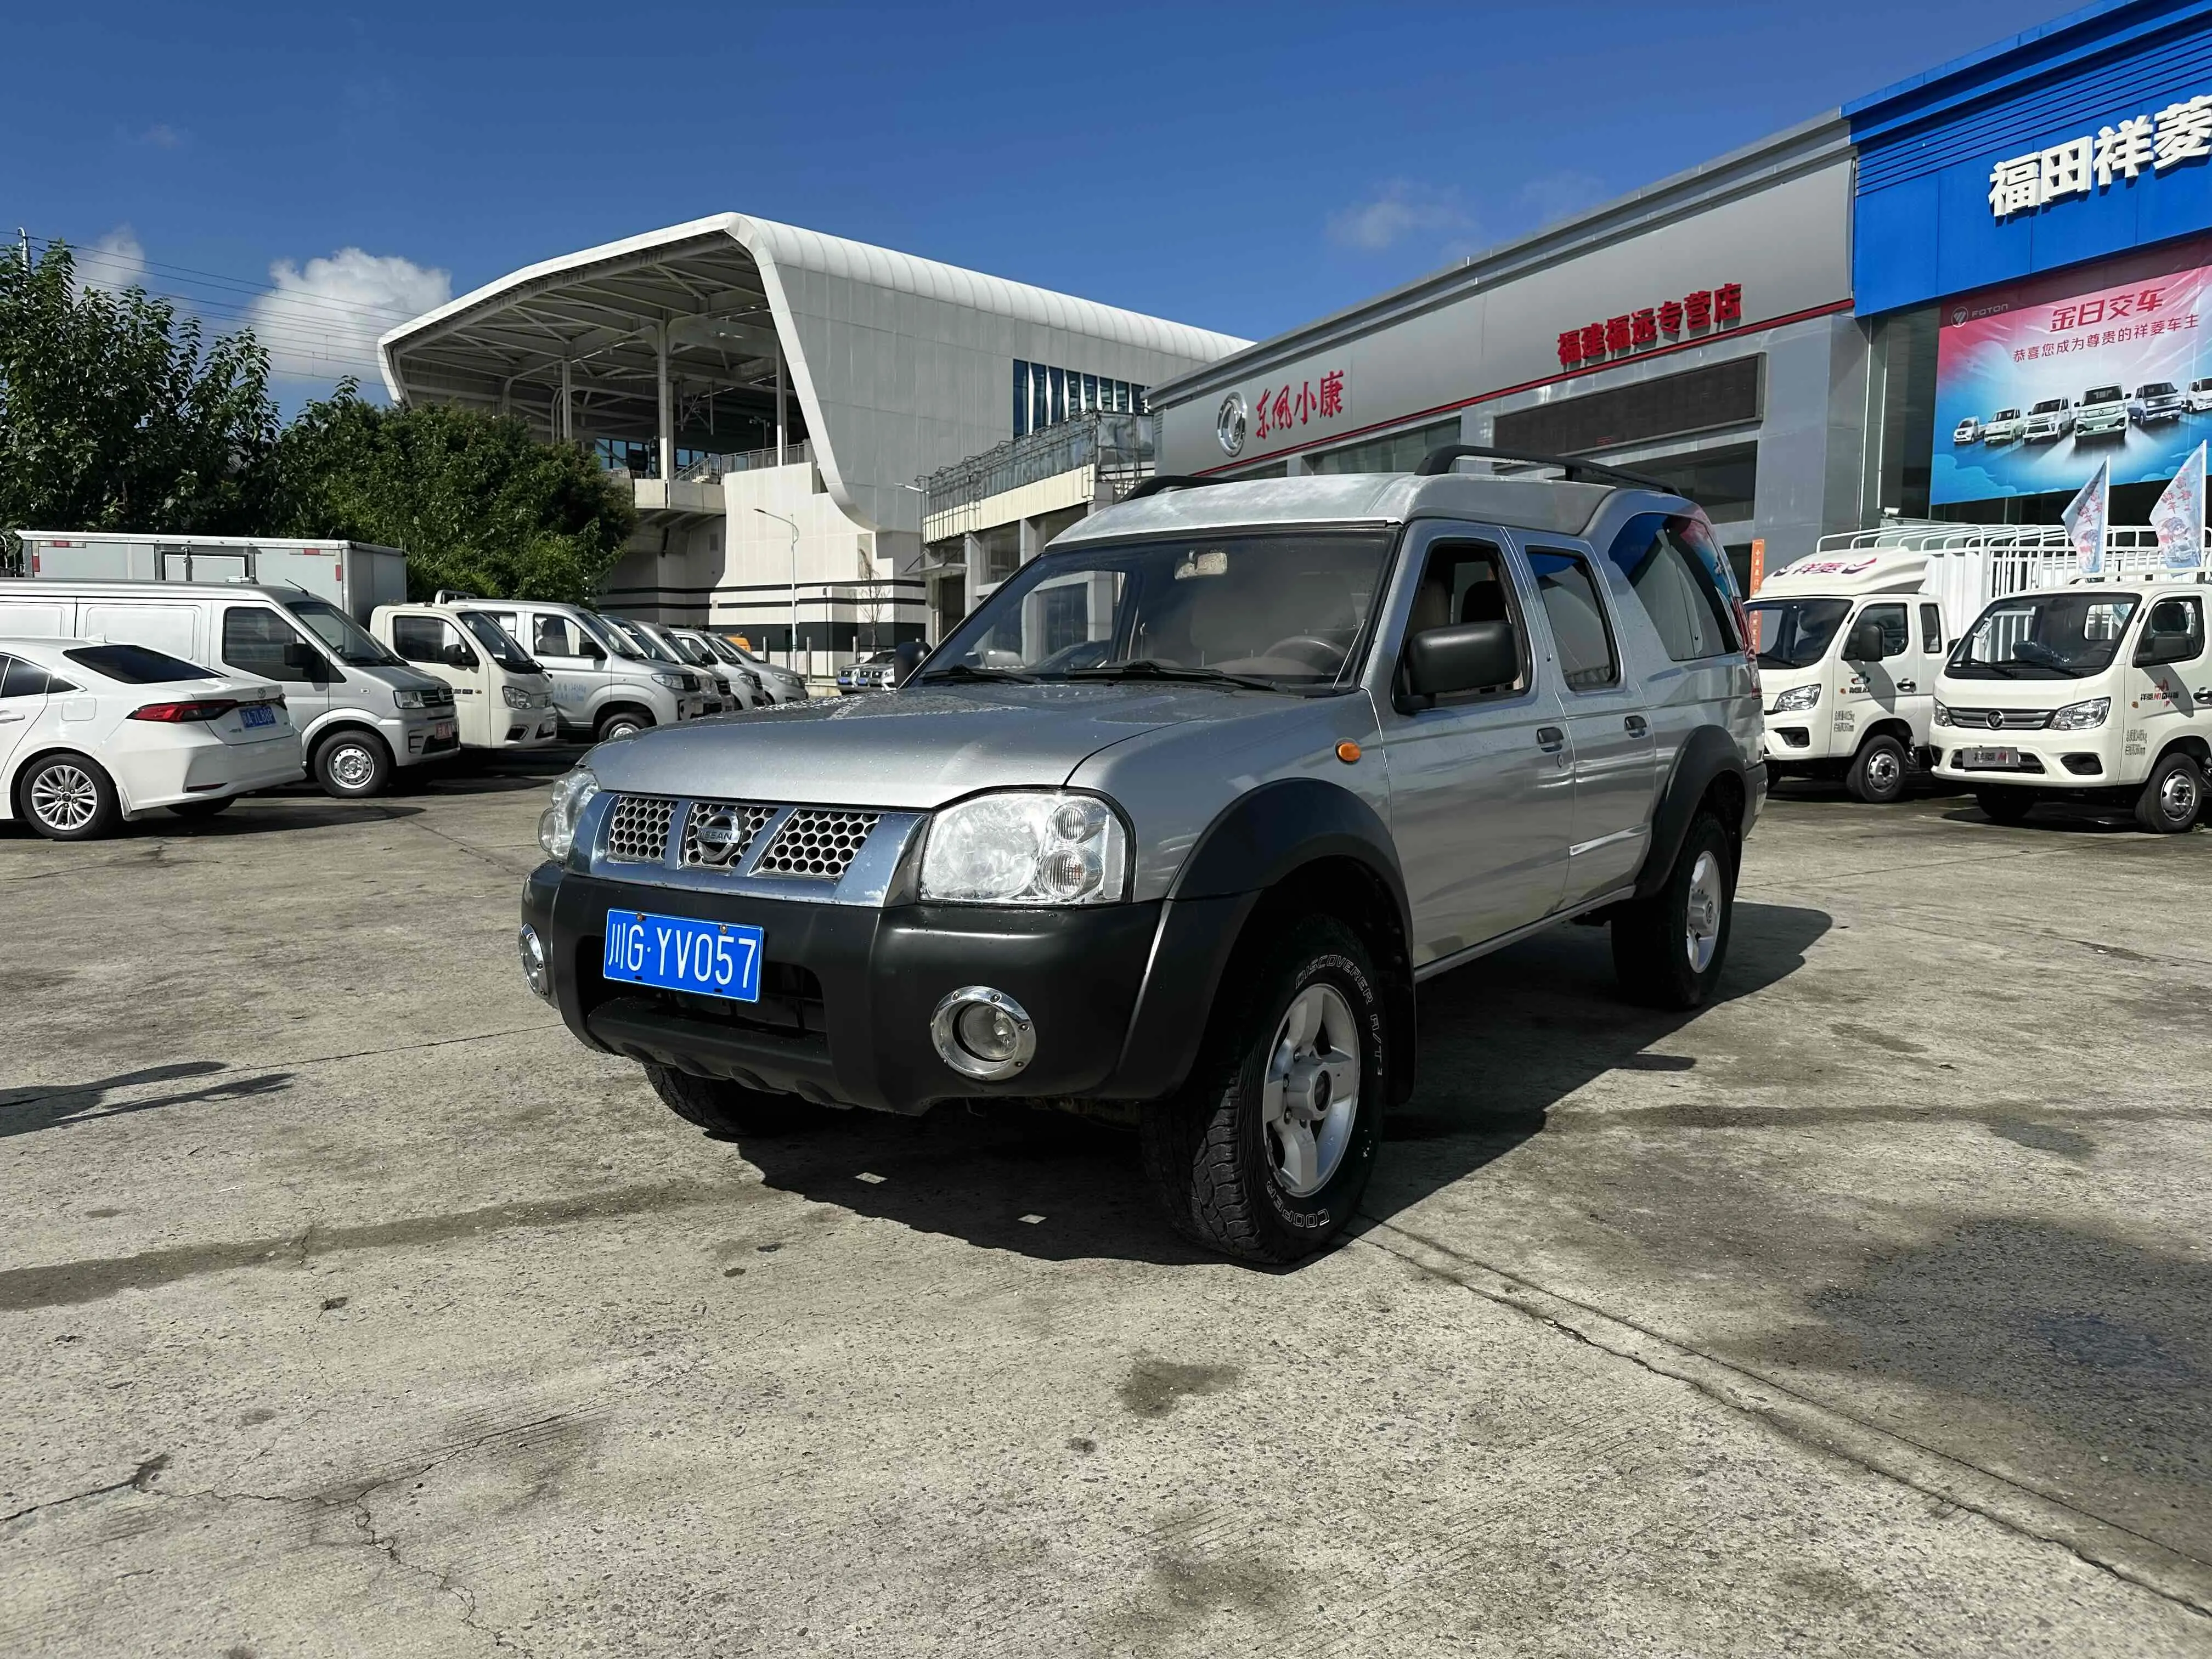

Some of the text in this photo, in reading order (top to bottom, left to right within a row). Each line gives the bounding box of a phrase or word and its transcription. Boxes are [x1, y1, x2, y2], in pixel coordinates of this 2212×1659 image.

[1989, 95, 2212, 217] 福田祥菱
[1557, 283, 1742, 365] 福建福远专营店
[1971, 303, 2008, 318] FOTON
[2013, 313, 2199, 363] 恭喜您成为尊贵的祥菱车主
[697, 829, 733, 840] NISSAN
[1295, 954, 1374, 1006] DISCOVERER
[1266, 1181, 1330, 1228] COOPER
